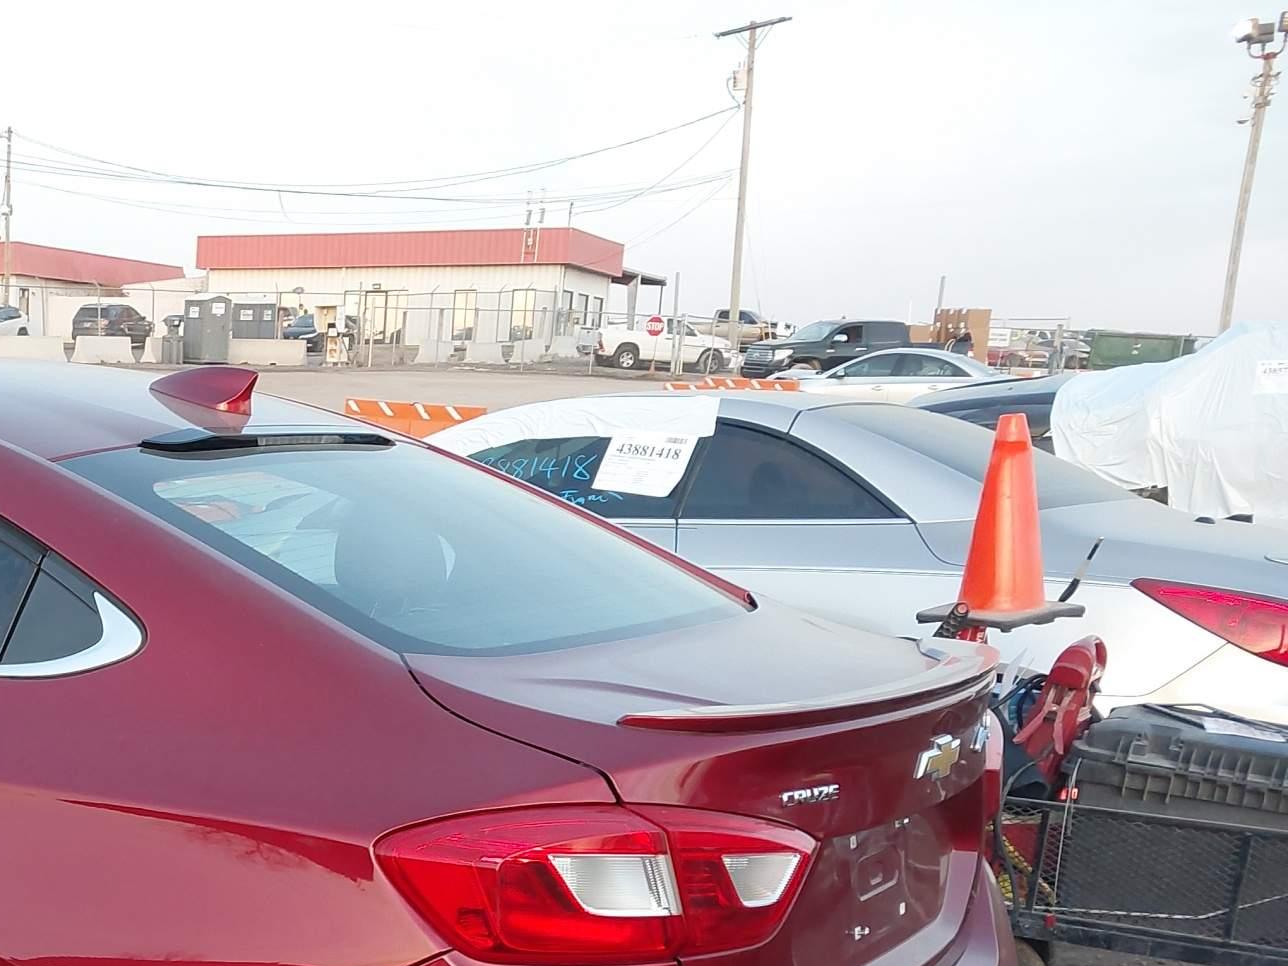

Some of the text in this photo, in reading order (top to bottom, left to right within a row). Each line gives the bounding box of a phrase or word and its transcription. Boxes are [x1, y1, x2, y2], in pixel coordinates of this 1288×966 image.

[646, 321, 665, 331] STOP
[615, 443, 682, 461] 43881418
[780, 784, 840, 807] CRUZE
